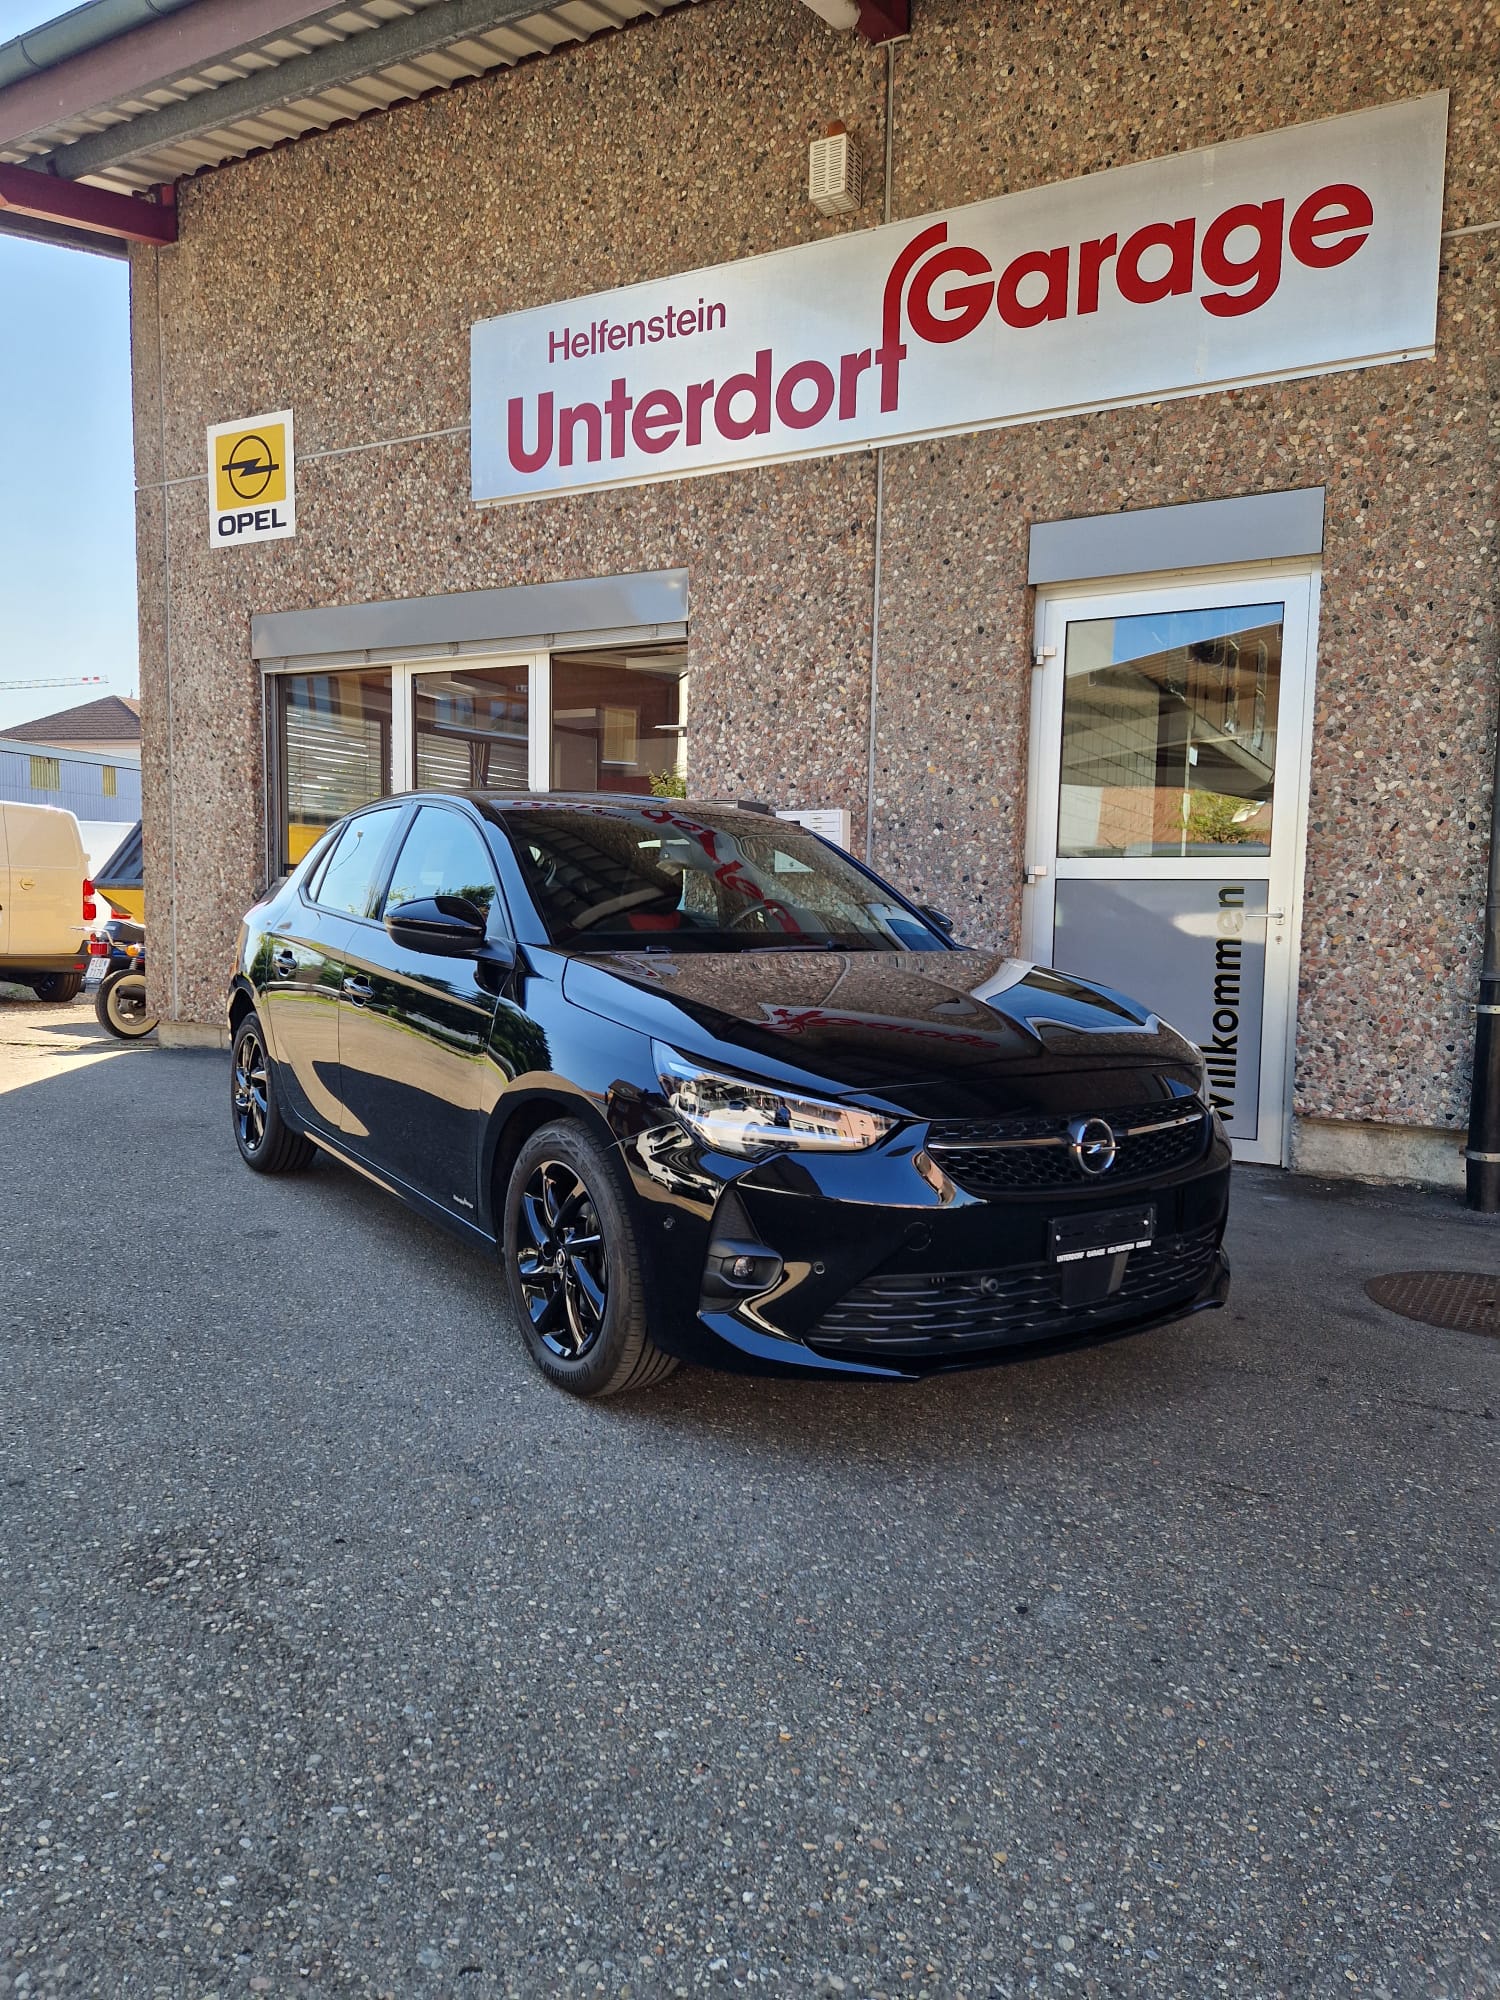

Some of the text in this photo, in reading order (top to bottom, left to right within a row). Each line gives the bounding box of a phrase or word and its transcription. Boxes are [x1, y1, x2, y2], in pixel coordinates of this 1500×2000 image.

[507, 183, 1374, 474] Unterdorf Garage
[548, 297, 728, 363] Helfenstein
[218, 508, 288, 537] OPEL
